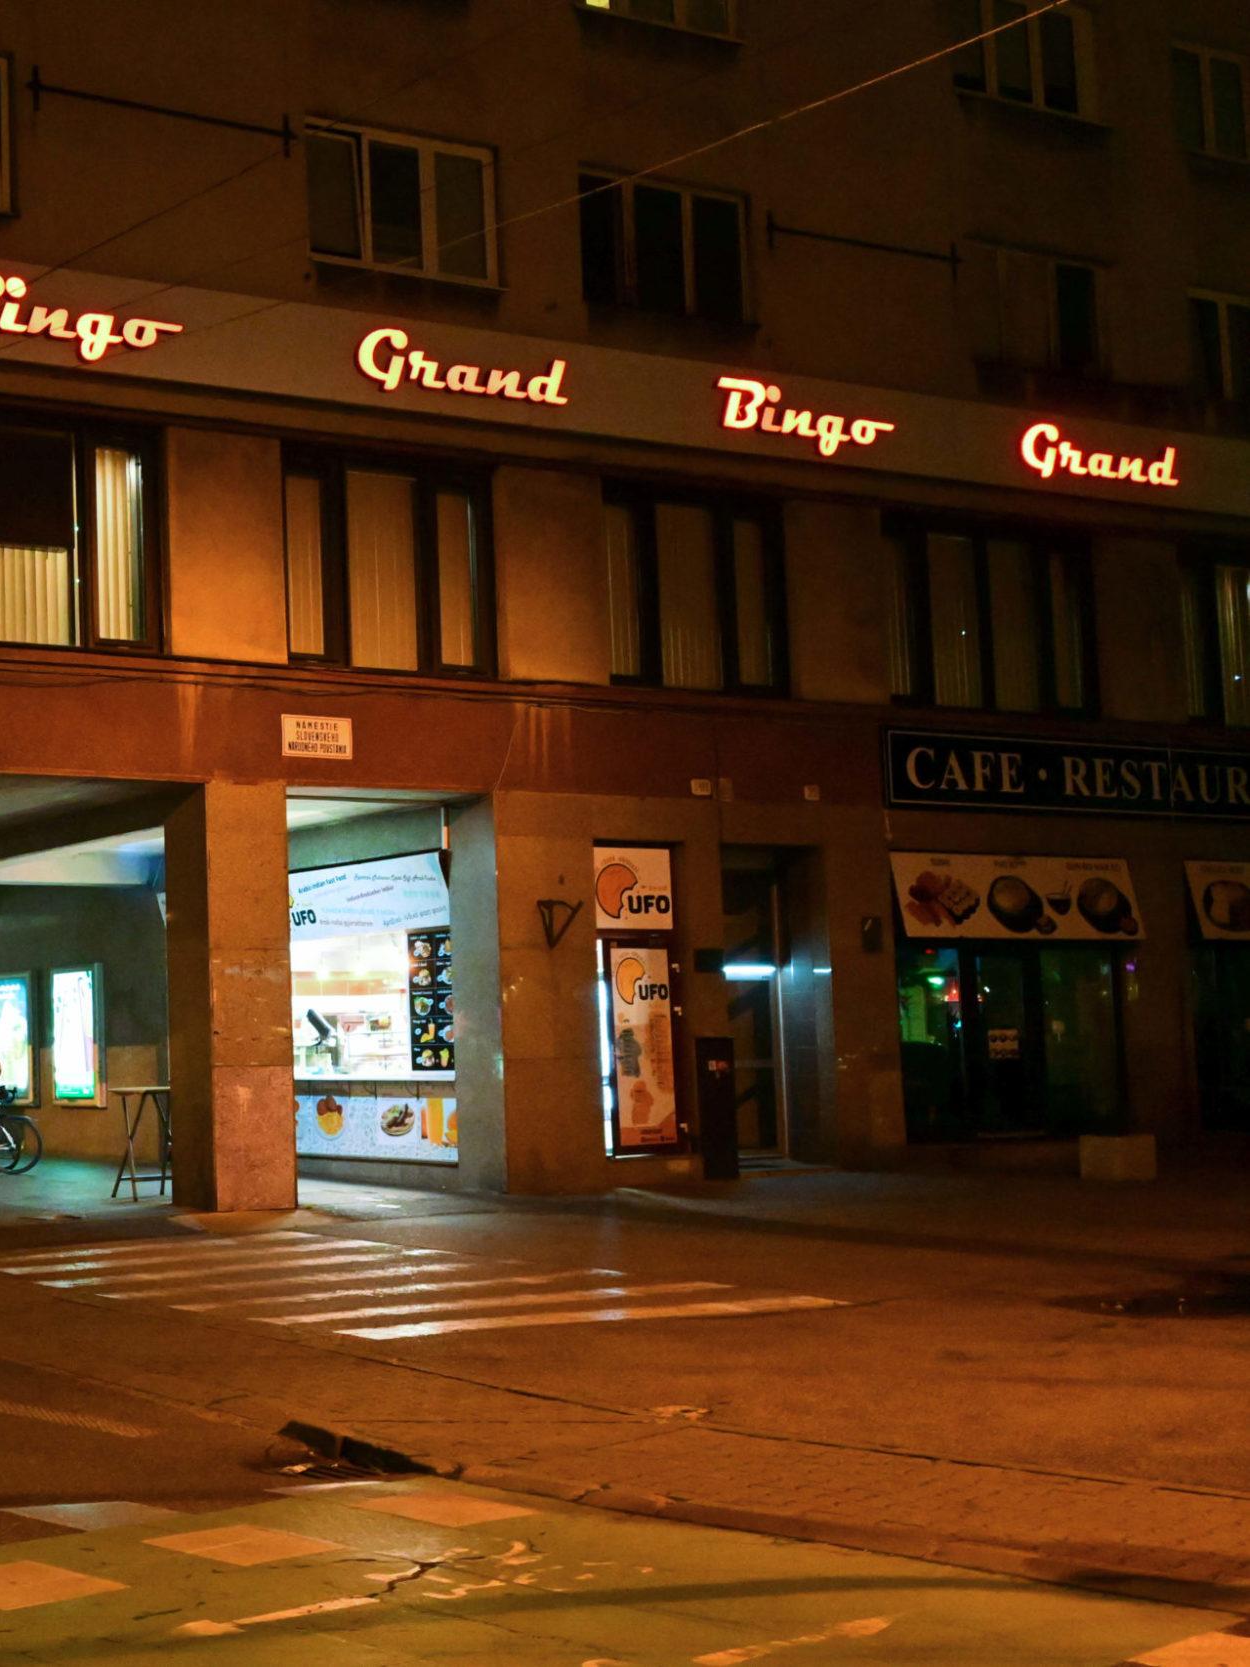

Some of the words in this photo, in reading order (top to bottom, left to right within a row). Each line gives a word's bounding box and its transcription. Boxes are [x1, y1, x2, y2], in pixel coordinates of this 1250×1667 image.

[355, 327, 569, 406] Grand
[717, 376, 896, 456] Bingo
[1019, 422, 1180, 487] Grand
[905, 746, 1025, 794] CAFE
[1061, 755, 1250, 805] RESTAUR
[291, 908, 317, 927] UFO
[627, 894, 671, 915] UFO
[637, 982, 670, 1002] UFO
